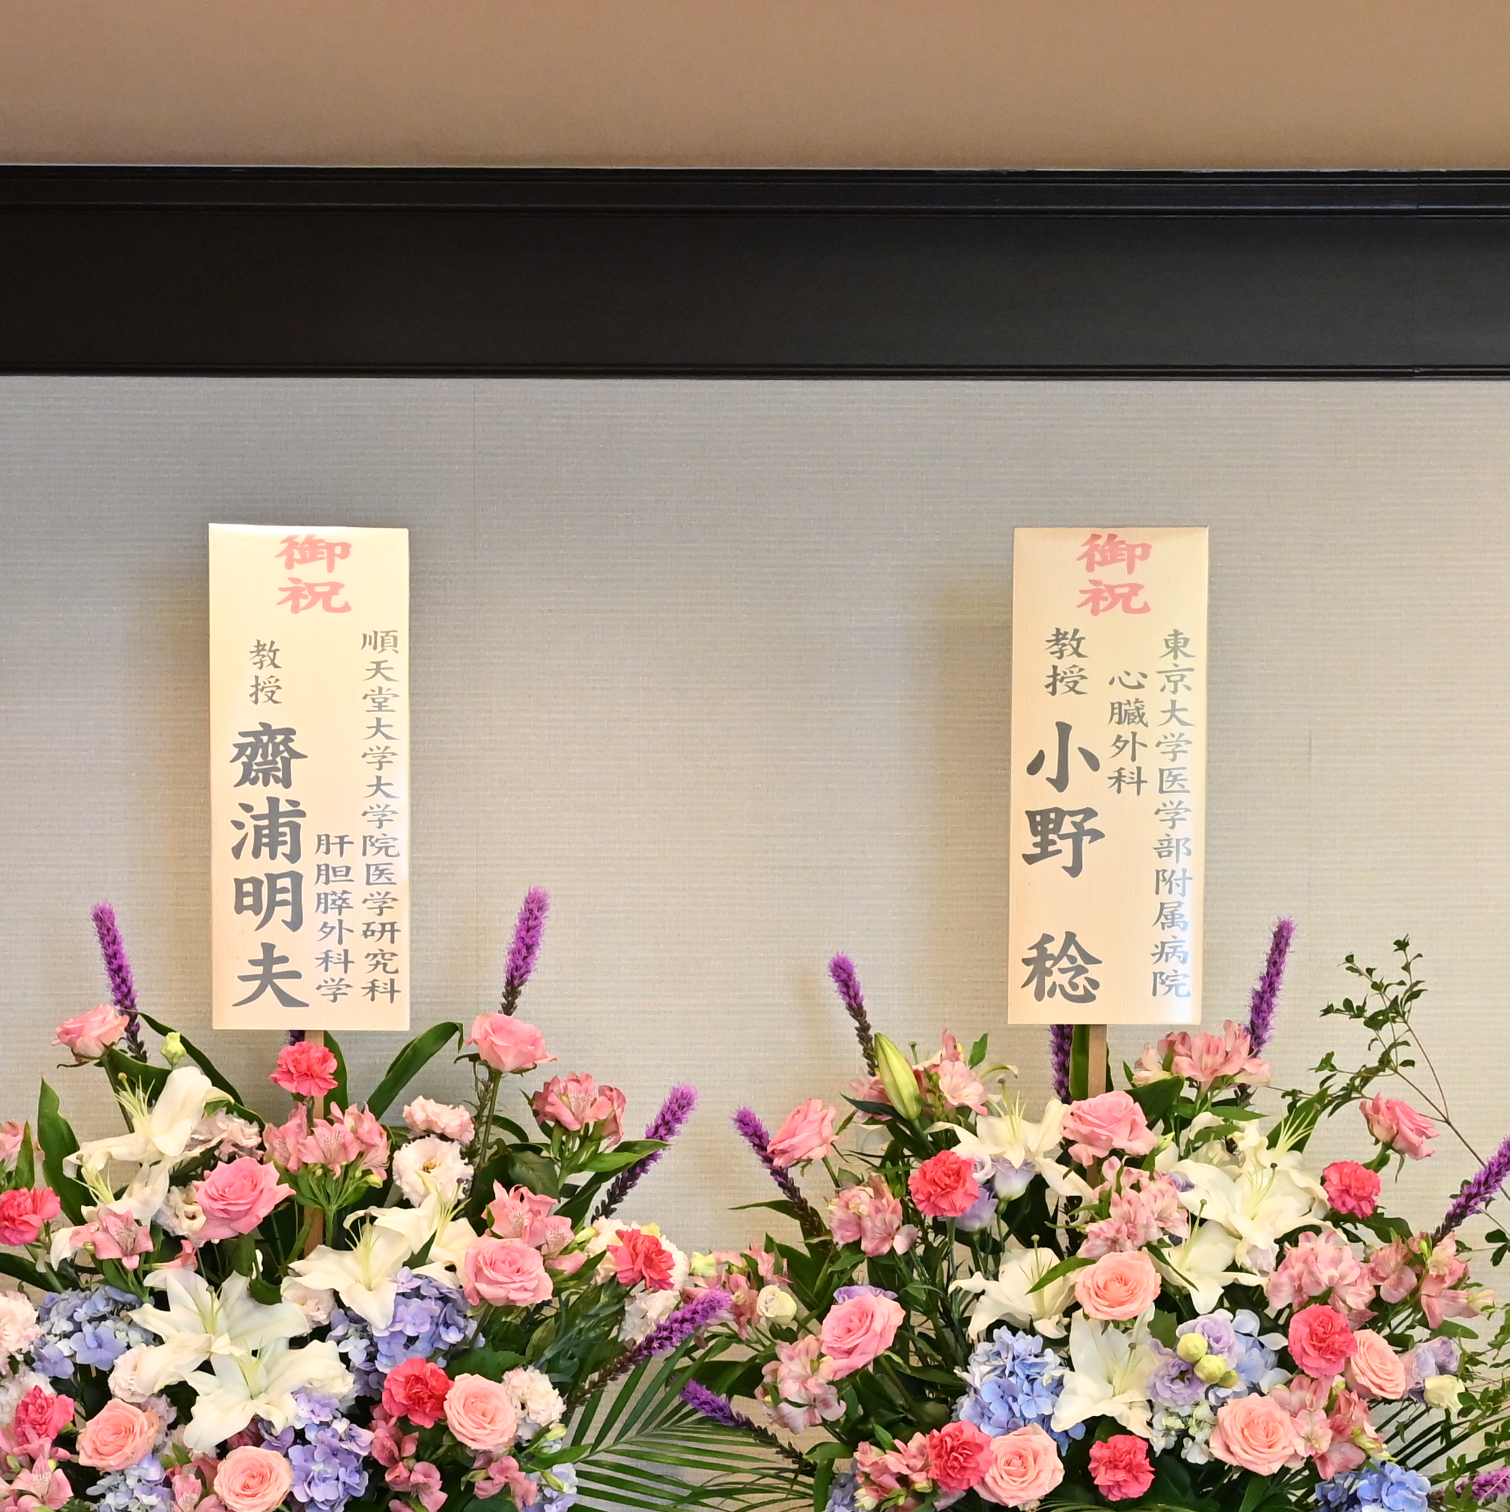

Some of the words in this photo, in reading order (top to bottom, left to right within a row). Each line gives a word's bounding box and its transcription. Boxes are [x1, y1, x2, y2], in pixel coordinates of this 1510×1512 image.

[274, 534, 353, 615] 御祝
[1076, 532, 1153, 617] 御祝
[248, 638, 283, 706] 教授
[1044, 627, 1089, 697] 教授
[1106, 668, 1149, 797] 心臓外科
[360, 629, 402, 1005] 順天堂大学大学院医学研究科
[1021, 720, 1106, 879] 小野
[1150, 628, 1196, 998] 東京大学医学部附属病院
[229, 721, 310, 1008] 齋浦明夫
[314, 833, 356, 1004] 肝胆膵外科学
[1020, 930, 1103, 1004] 稔
